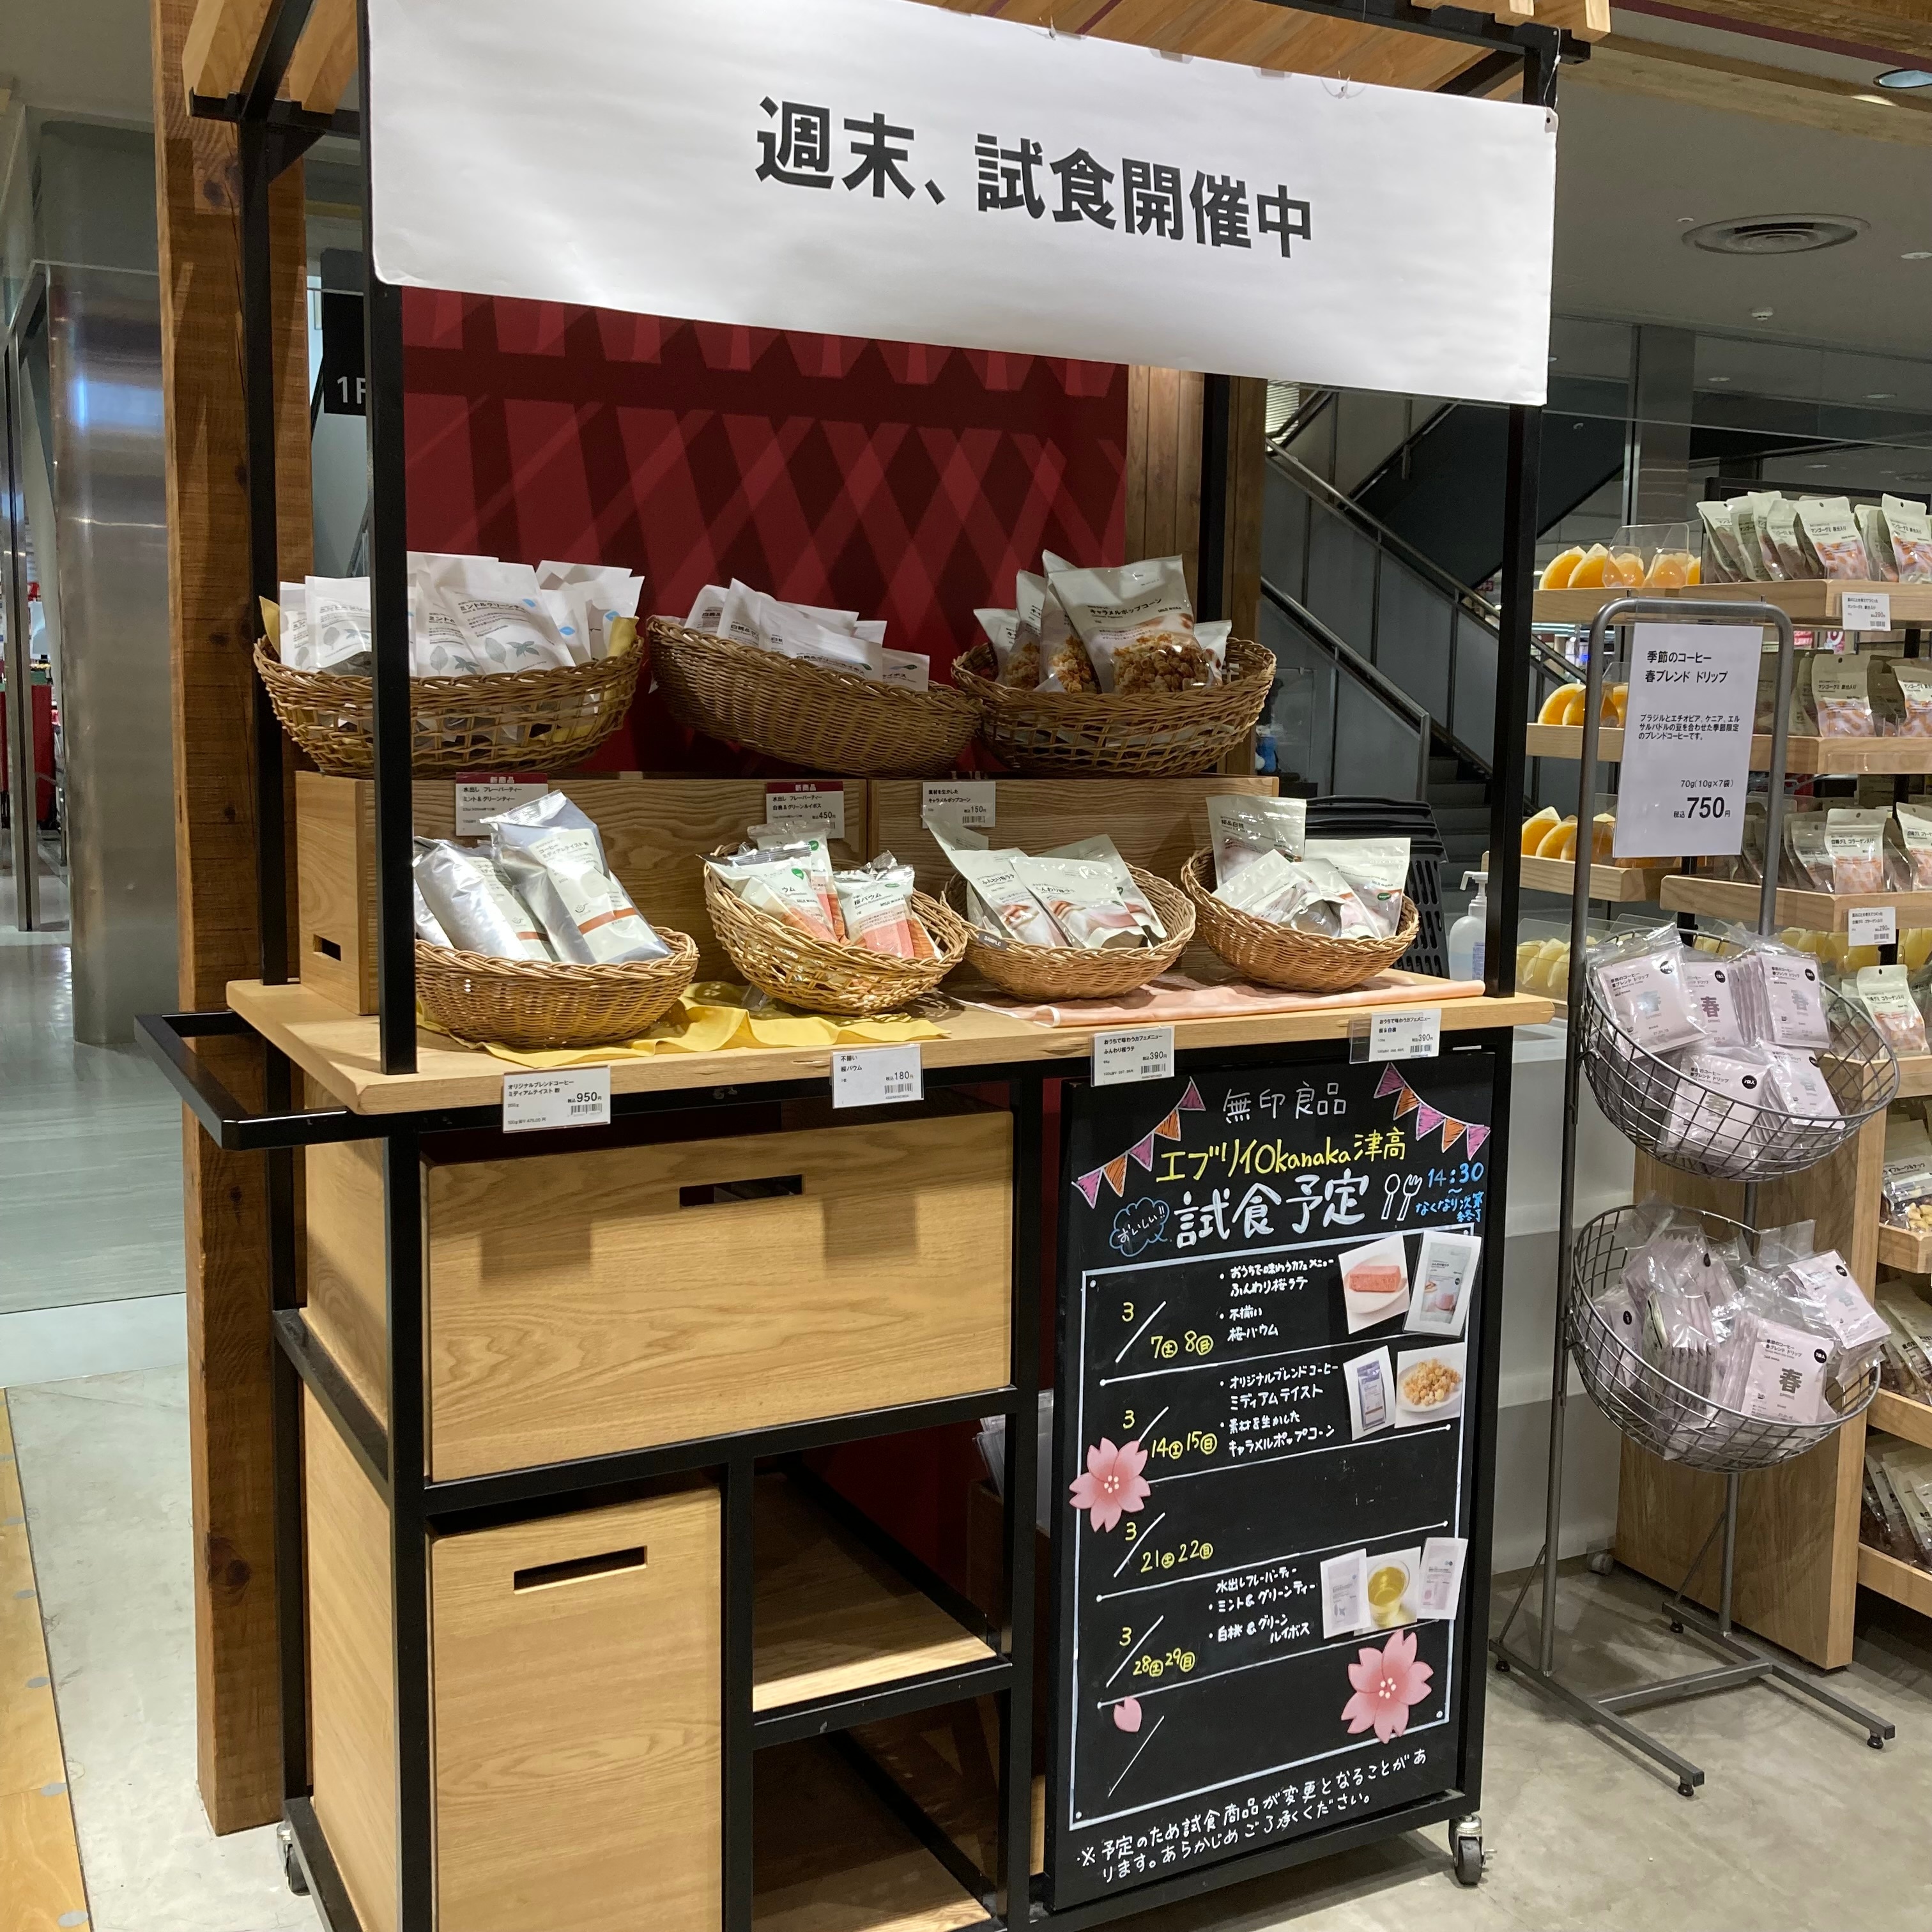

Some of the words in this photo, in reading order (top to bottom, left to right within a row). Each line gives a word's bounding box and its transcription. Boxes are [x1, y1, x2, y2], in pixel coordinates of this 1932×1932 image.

[756, 96, 1312, 258] 週末、試食開催中
[1090, 598, 1162, 615] キャラメルポップコーン
[1647, 650, 1712, 664] 季節のコーヒー
[1644, 670, 1690, 684] 春ブレンド
[1696, 670, 1729, 684] ドリップ
[1638, 732, 1703, 740] のブレンドコーヒーです。
[1639, 723, 1739, 732] サルバドルの豆を合わせた季節限定
[984, 935, 1002, 947] SAMPLE
[1700, 996, 1720, 1018] 春
[1103, 1046, 1135, 1055] ふんわり桜ラテ
[508, 1080, 574, 1089] オリジナルブレンドコーヒー
[509, 1089, 553, 1097] ミディアムテイスト
[1223, 1082, 1346, 1122] 無印良品
[1427, 1162, 1485, 1188] 14:30
[1173, 1168, 1370, 1248] 試食予定
[1456, 1208, 1482, 1223] 終了
[1230, 1257, 1335, 1281] おうちで味わうカフェメニュー
[1230, 1276, 1308, 1299] ふんわり桜ラテ
[1121, 1301, 1135, 1322] 3
[1229, 1305, 1264, 1321] 不揃い
[1227, 1323, 1279, 1342] 桜バウム
[1229, 1363, 1340, 1390] オリジナルブレンドコーヒー
[1779, 1367, 1803, 1394] 春
[1230, 1384, 1324, 1411] ミディアムテイスト
[1123, 1409, 1136, 1430] 3
[1228, 1413, 1301, 1435] 素材を生かした
[1228, 1425, 1336, 1458] キャラメルポップコーン
[1124, 1521, 1138, 1541] 3
[1215, 1565, 1298, 1593] 水出しフレーバーティー
[1118, 1626, 1132, 1646] 3
[1269, 1621, 1311, 1644] ルイボス
[1103, 1794, 1371, 1883] ります。あらかじめご了承ください。
